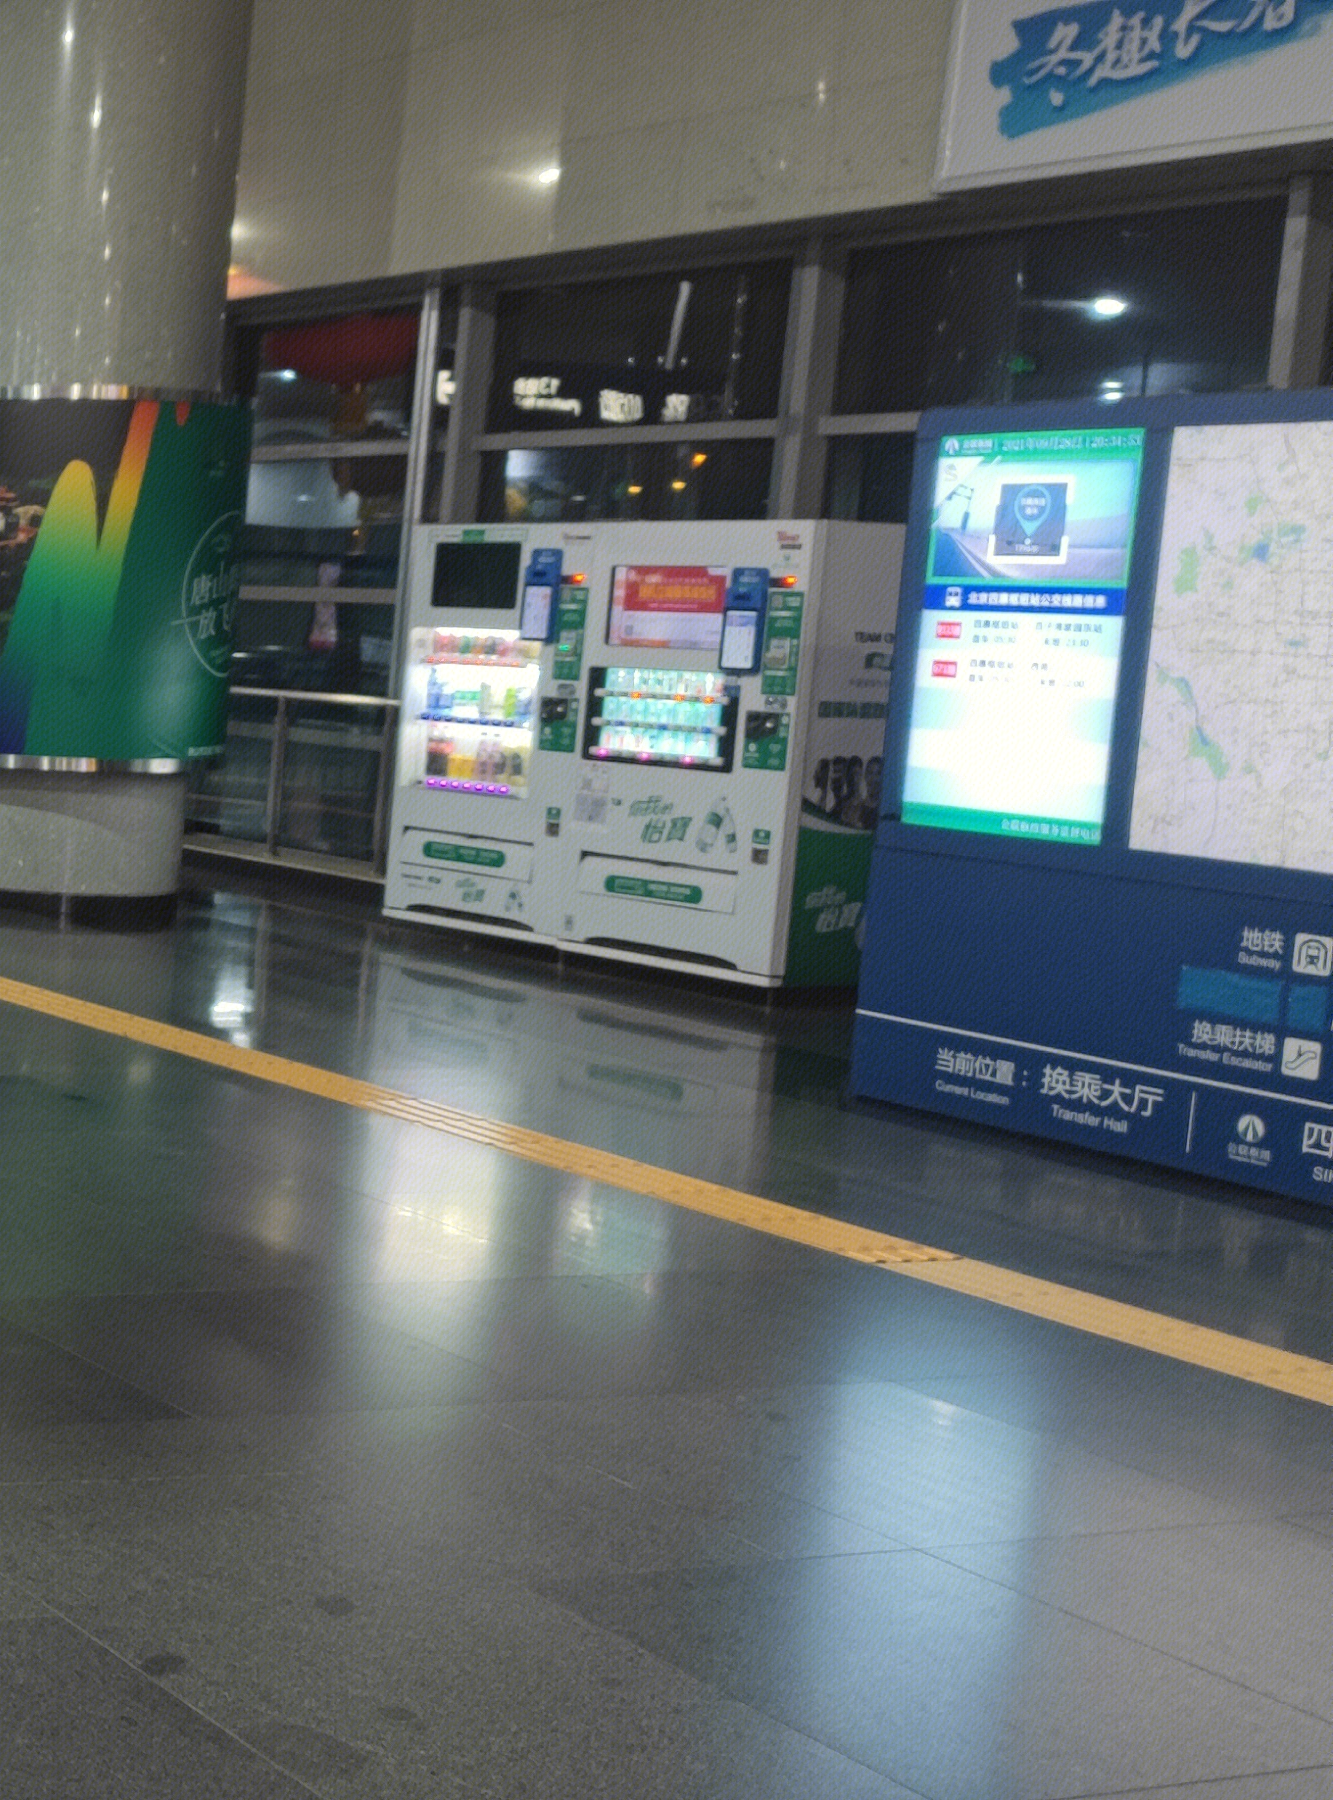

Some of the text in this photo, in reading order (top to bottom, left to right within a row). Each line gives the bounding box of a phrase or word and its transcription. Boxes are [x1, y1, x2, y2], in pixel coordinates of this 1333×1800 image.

[1241, 926, 1284, 954] 地铁
[1238, 951, 1281, 971] Subway
[1191, 1019, 1276, 1056] 换乘扶梯
[1177, 1043, 1273, 1073] Transfer Escalator
[970, 1085, 1009, 1106] Location
[1040, 1064, 1164, 1118] 换乘大厅
[1051, 1104, 1128, 1134] Transfer Hall
